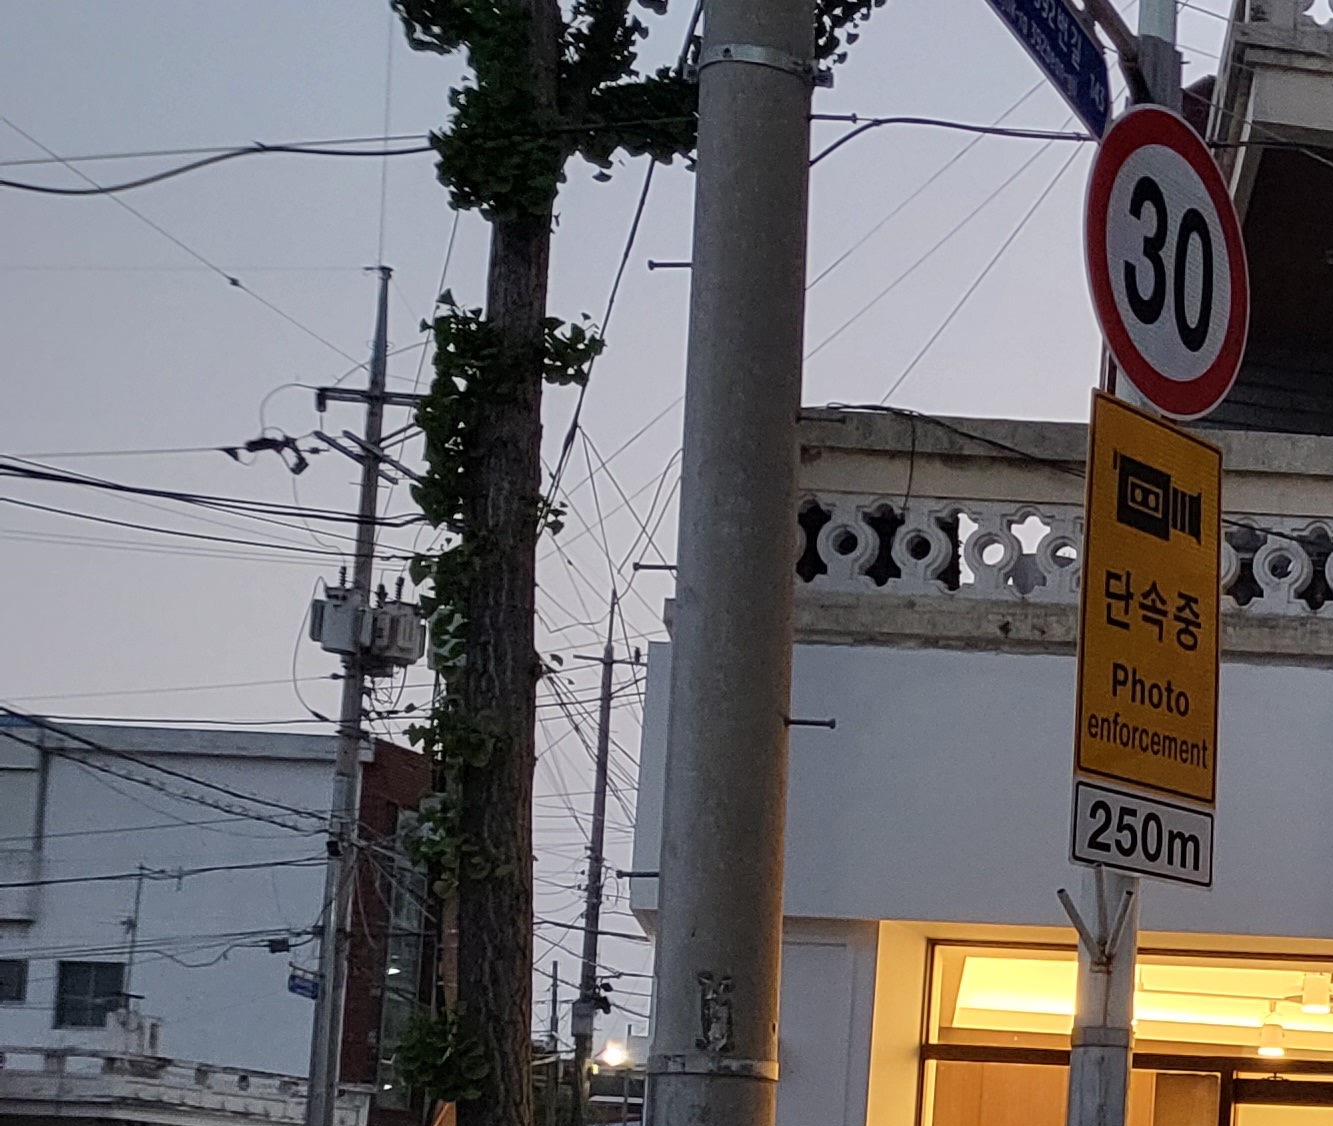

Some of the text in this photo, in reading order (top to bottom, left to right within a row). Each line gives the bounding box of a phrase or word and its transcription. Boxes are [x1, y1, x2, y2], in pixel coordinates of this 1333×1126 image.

[1124, 176, 1214, 352] 30
[1104, 570, 1202, 651] 단속중
[1112, 662, 1190, 717] Photo
[1088, 712, 1208, 769] enforcement
[1087, 800, 1200, 871] 250m
